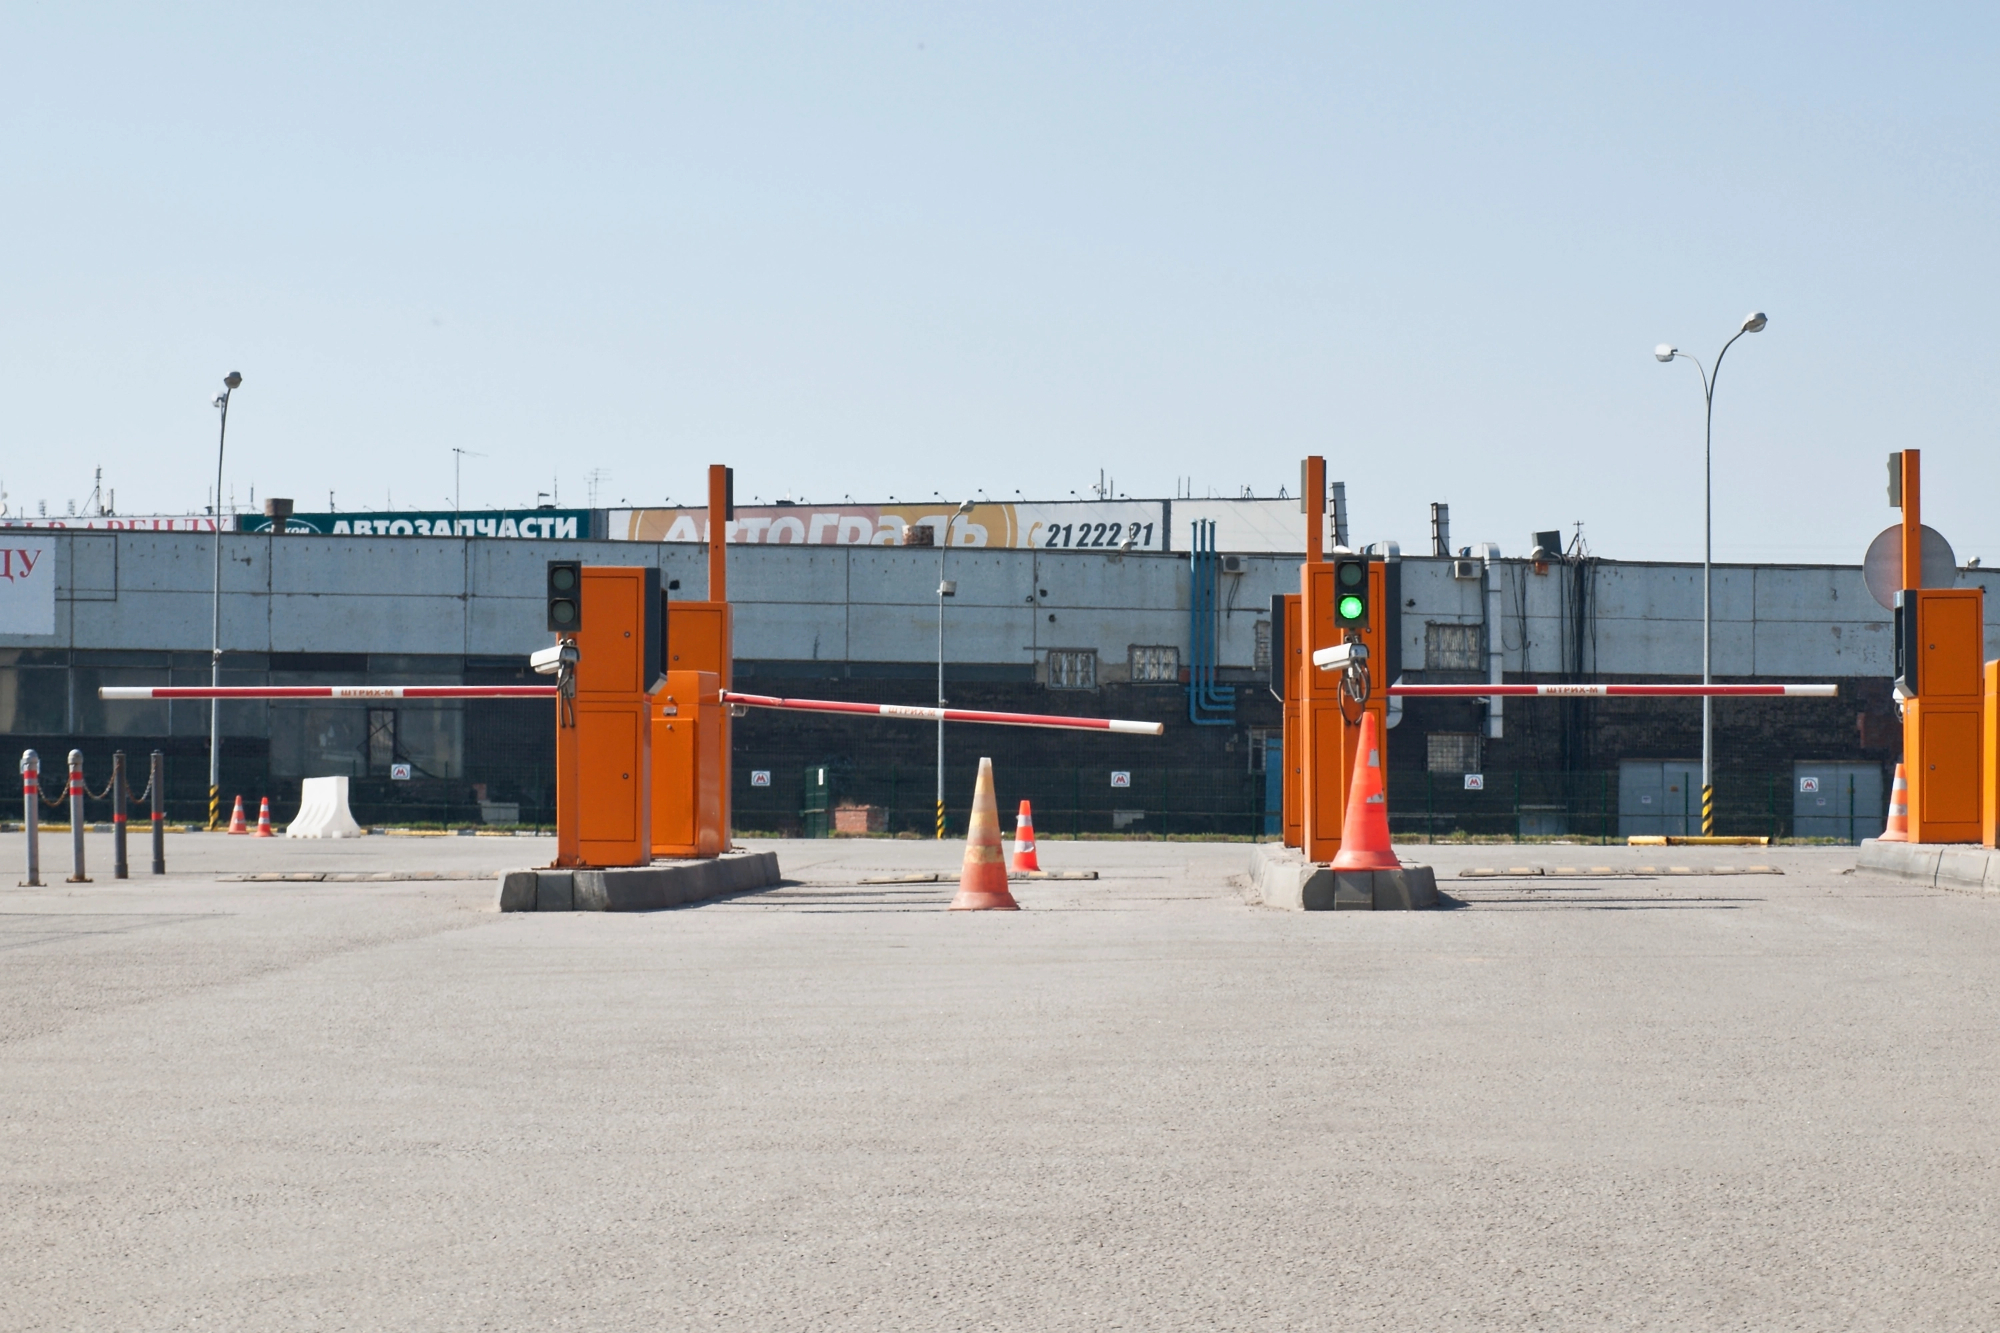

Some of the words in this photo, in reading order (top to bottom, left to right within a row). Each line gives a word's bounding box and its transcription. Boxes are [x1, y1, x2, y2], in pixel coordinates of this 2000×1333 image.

[332, 516, 578, 539] АВТОЗАПЧАСТИ
[1045, 523, 1073, 547] 21
[1076, 522, 1122, 547] 222
[1129, 522, 1154, 547] 21
[341, 689, 394, 697] ШТРИХ-М
[1546, 686, 1598, 694] ШТРИХ-М
[888, 706, 936, 717] ШТРИХ-М
